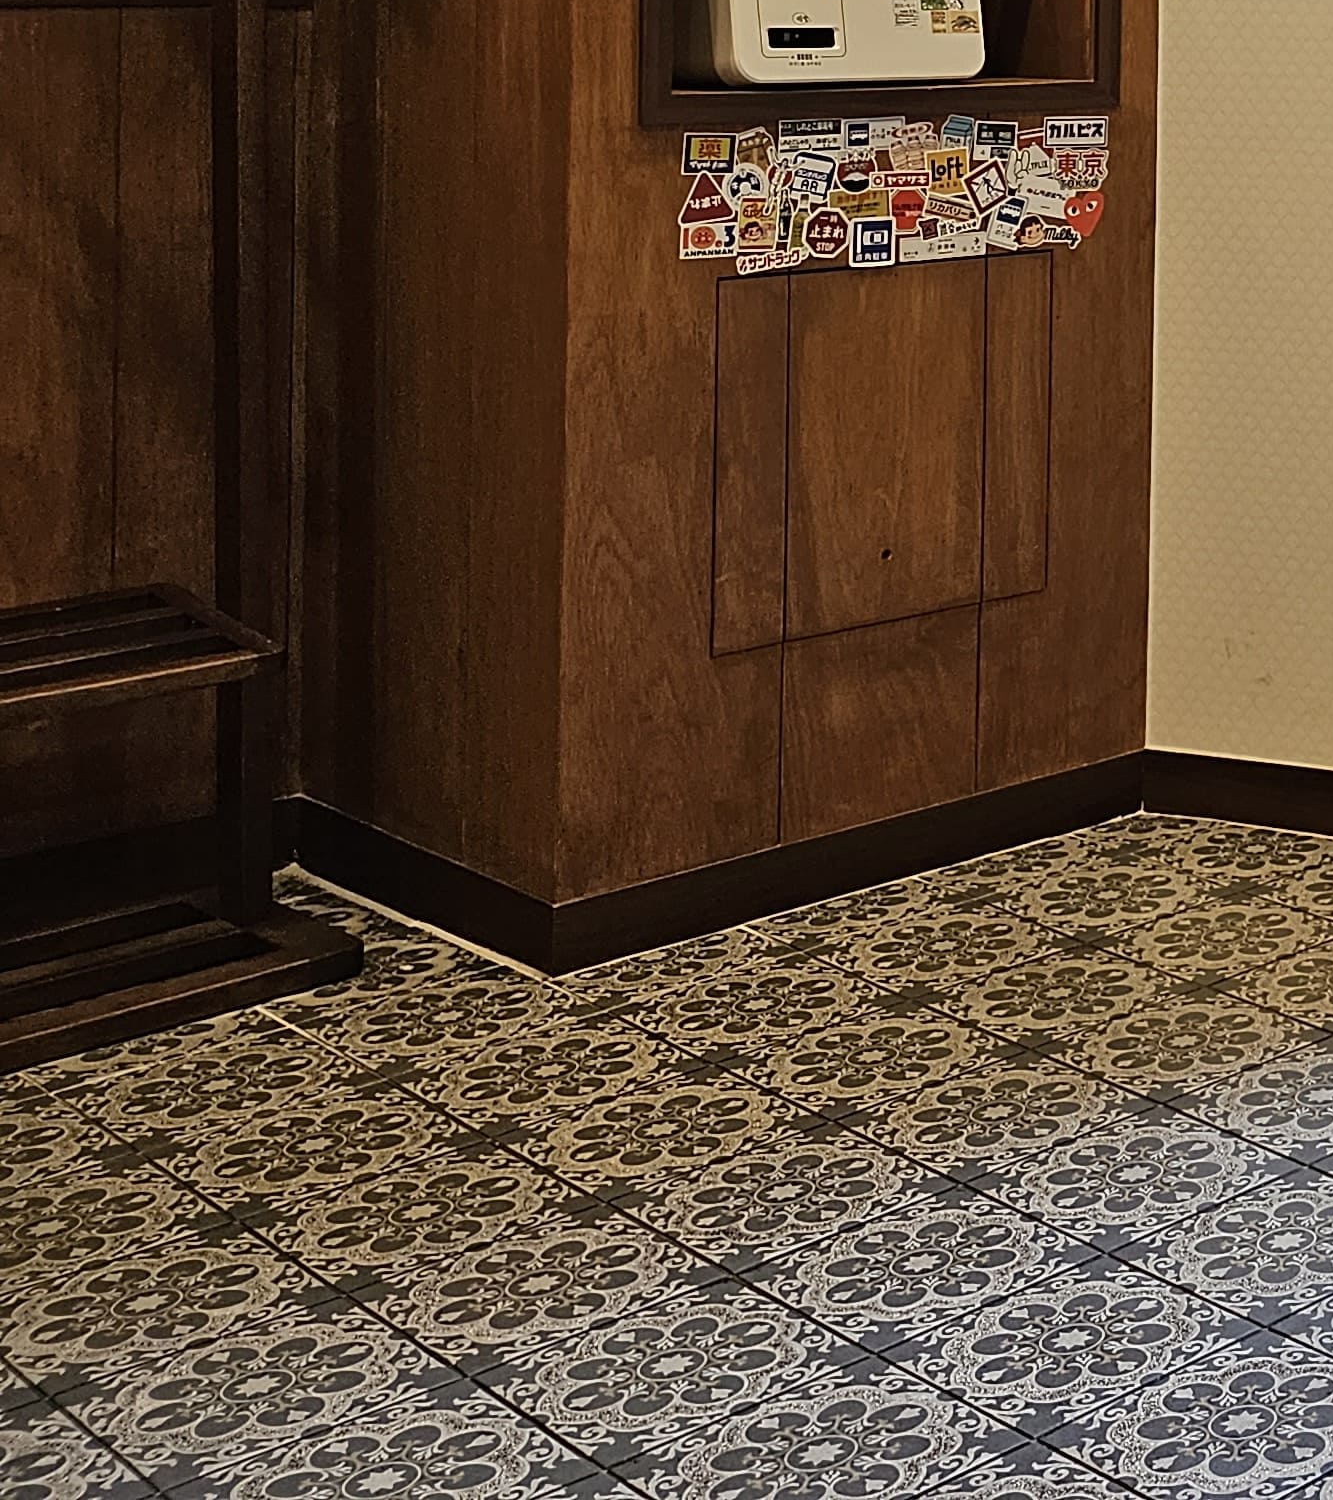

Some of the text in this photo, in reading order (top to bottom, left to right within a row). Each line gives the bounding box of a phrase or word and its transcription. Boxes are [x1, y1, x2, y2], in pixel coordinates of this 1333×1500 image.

[1048, 123, 1104, 138] カルピス
[1056, 151, 1105, 177] 東京
[887, 174, 928, 184] ヤマザキ
[1060, 178, 1100, 189] TOKYO
[929, 200, 970, 216] リカバリー
[809, 226, 844, 238] 止まれ
[1043, 226, 1081, 248] Milky
[815, 242, 836, 251] STOP
[684, 249, 734, 257] ANPANMAN
